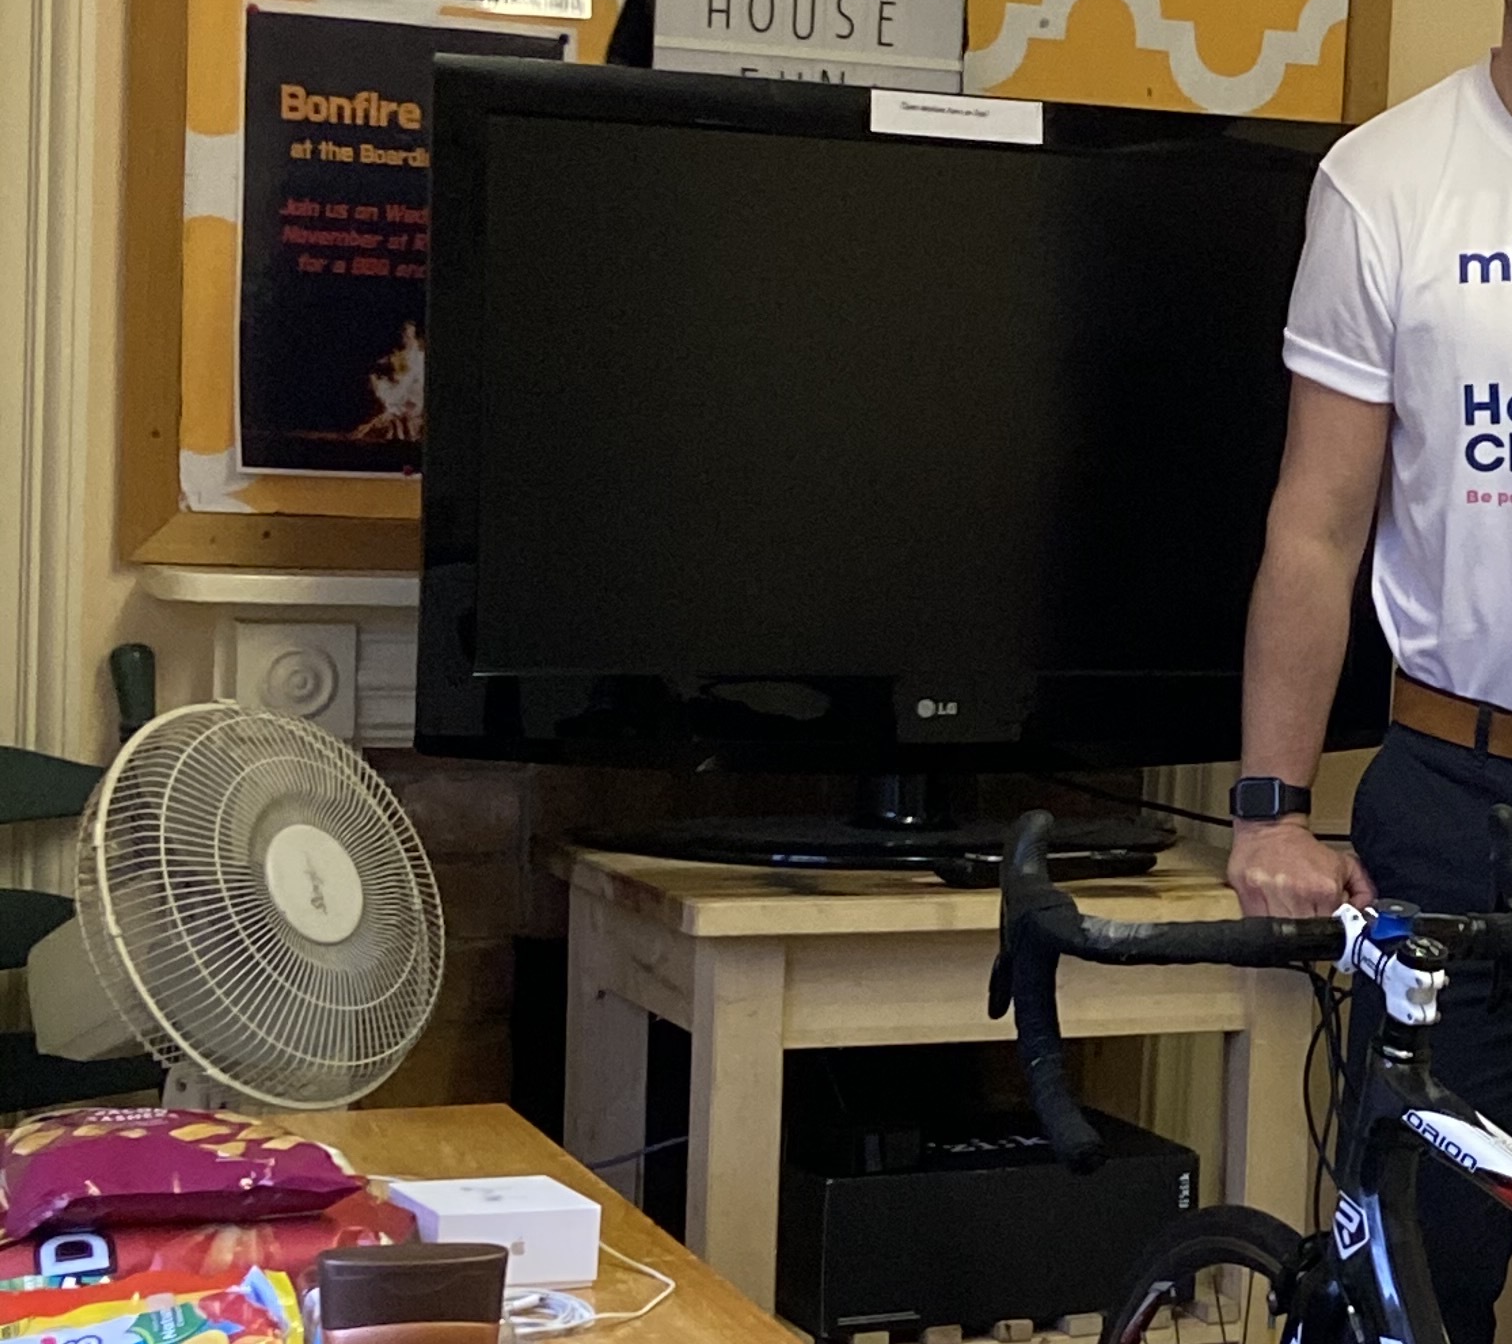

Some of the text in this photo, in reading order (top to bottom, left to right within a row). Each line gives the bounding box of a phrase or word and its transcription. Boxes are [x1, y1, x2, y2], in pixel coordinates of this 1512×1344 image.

[280, 83, 422, 130] Bonfire
[290, 139, 312, 160] at
[318, 141, 354, 163] the
[1466, 489, 1492, 504] Be
